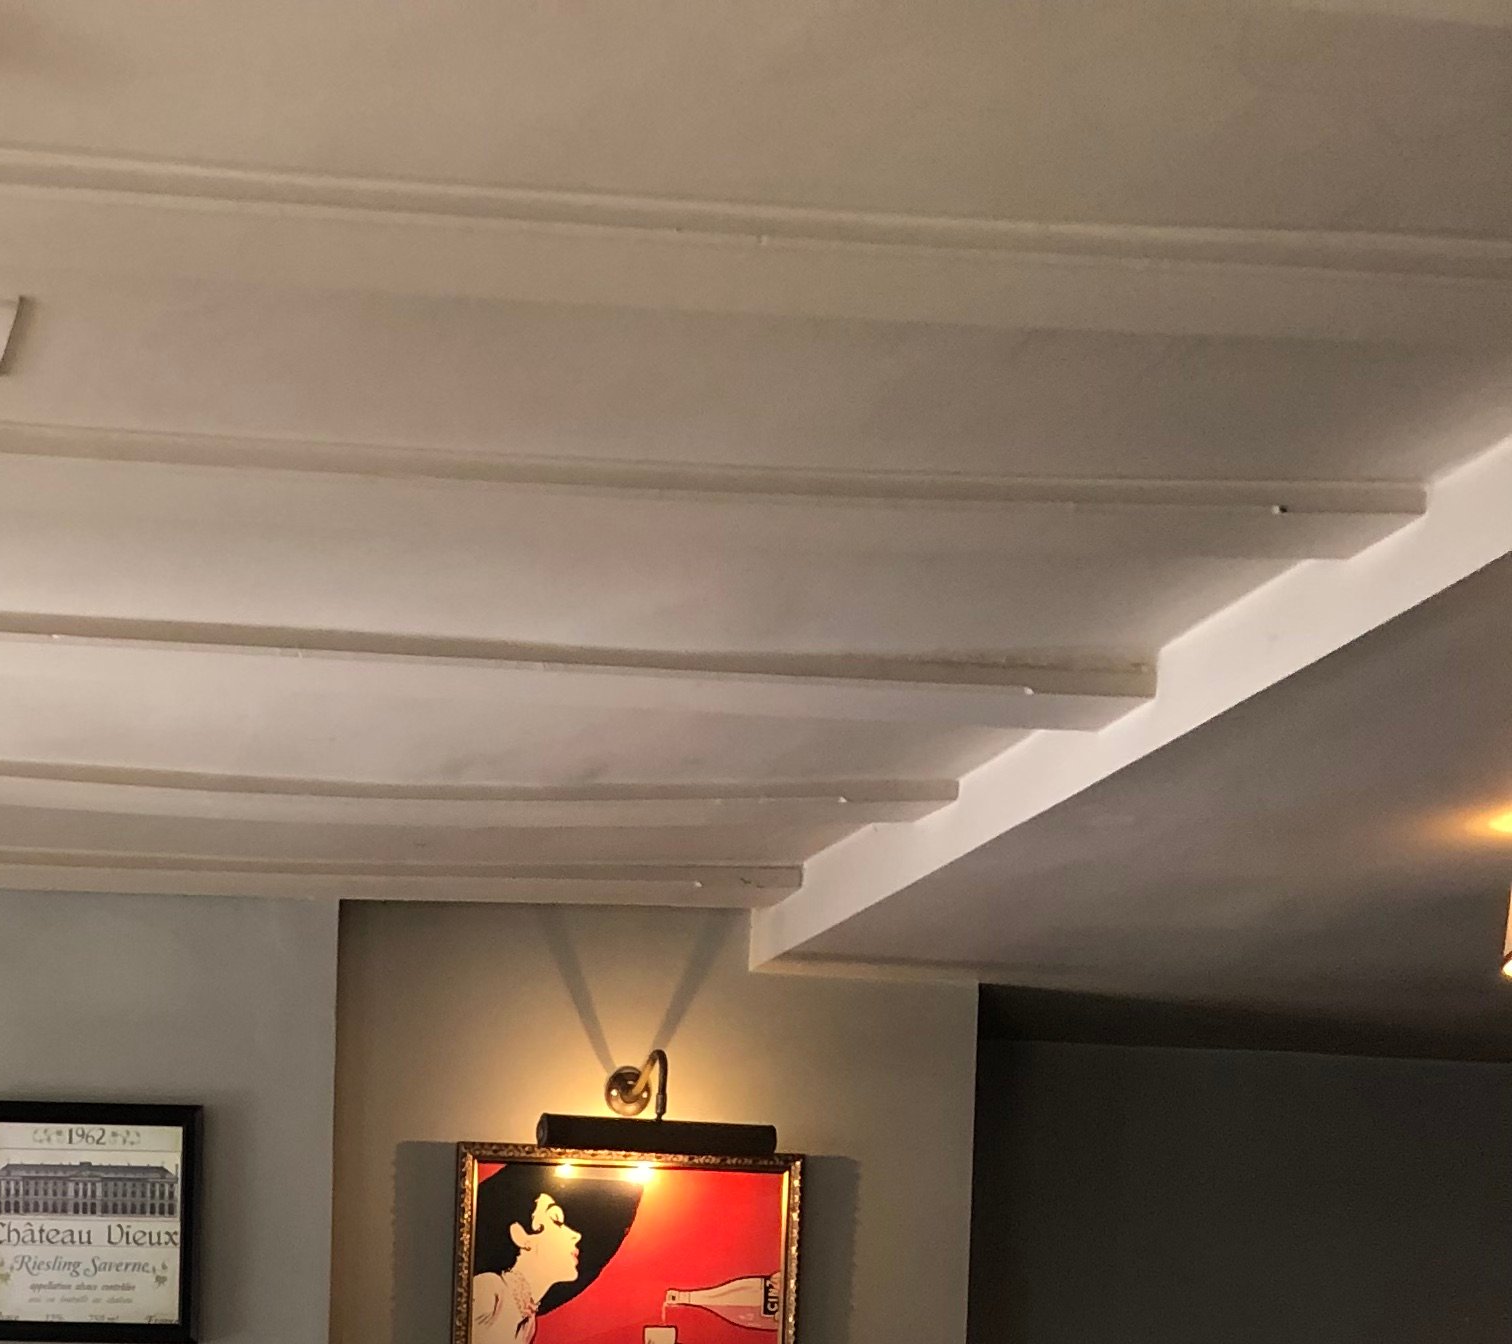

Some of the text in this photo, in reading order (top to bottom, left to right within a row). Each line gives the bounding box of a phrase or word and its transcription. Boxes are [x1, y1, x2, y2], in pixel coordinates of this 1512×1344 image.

[67, 1127, 106, 1145] 1962
[107, 1224, 179, 1246] Vieux
[11, 1255, 156, 1278] Riesling Saverne
